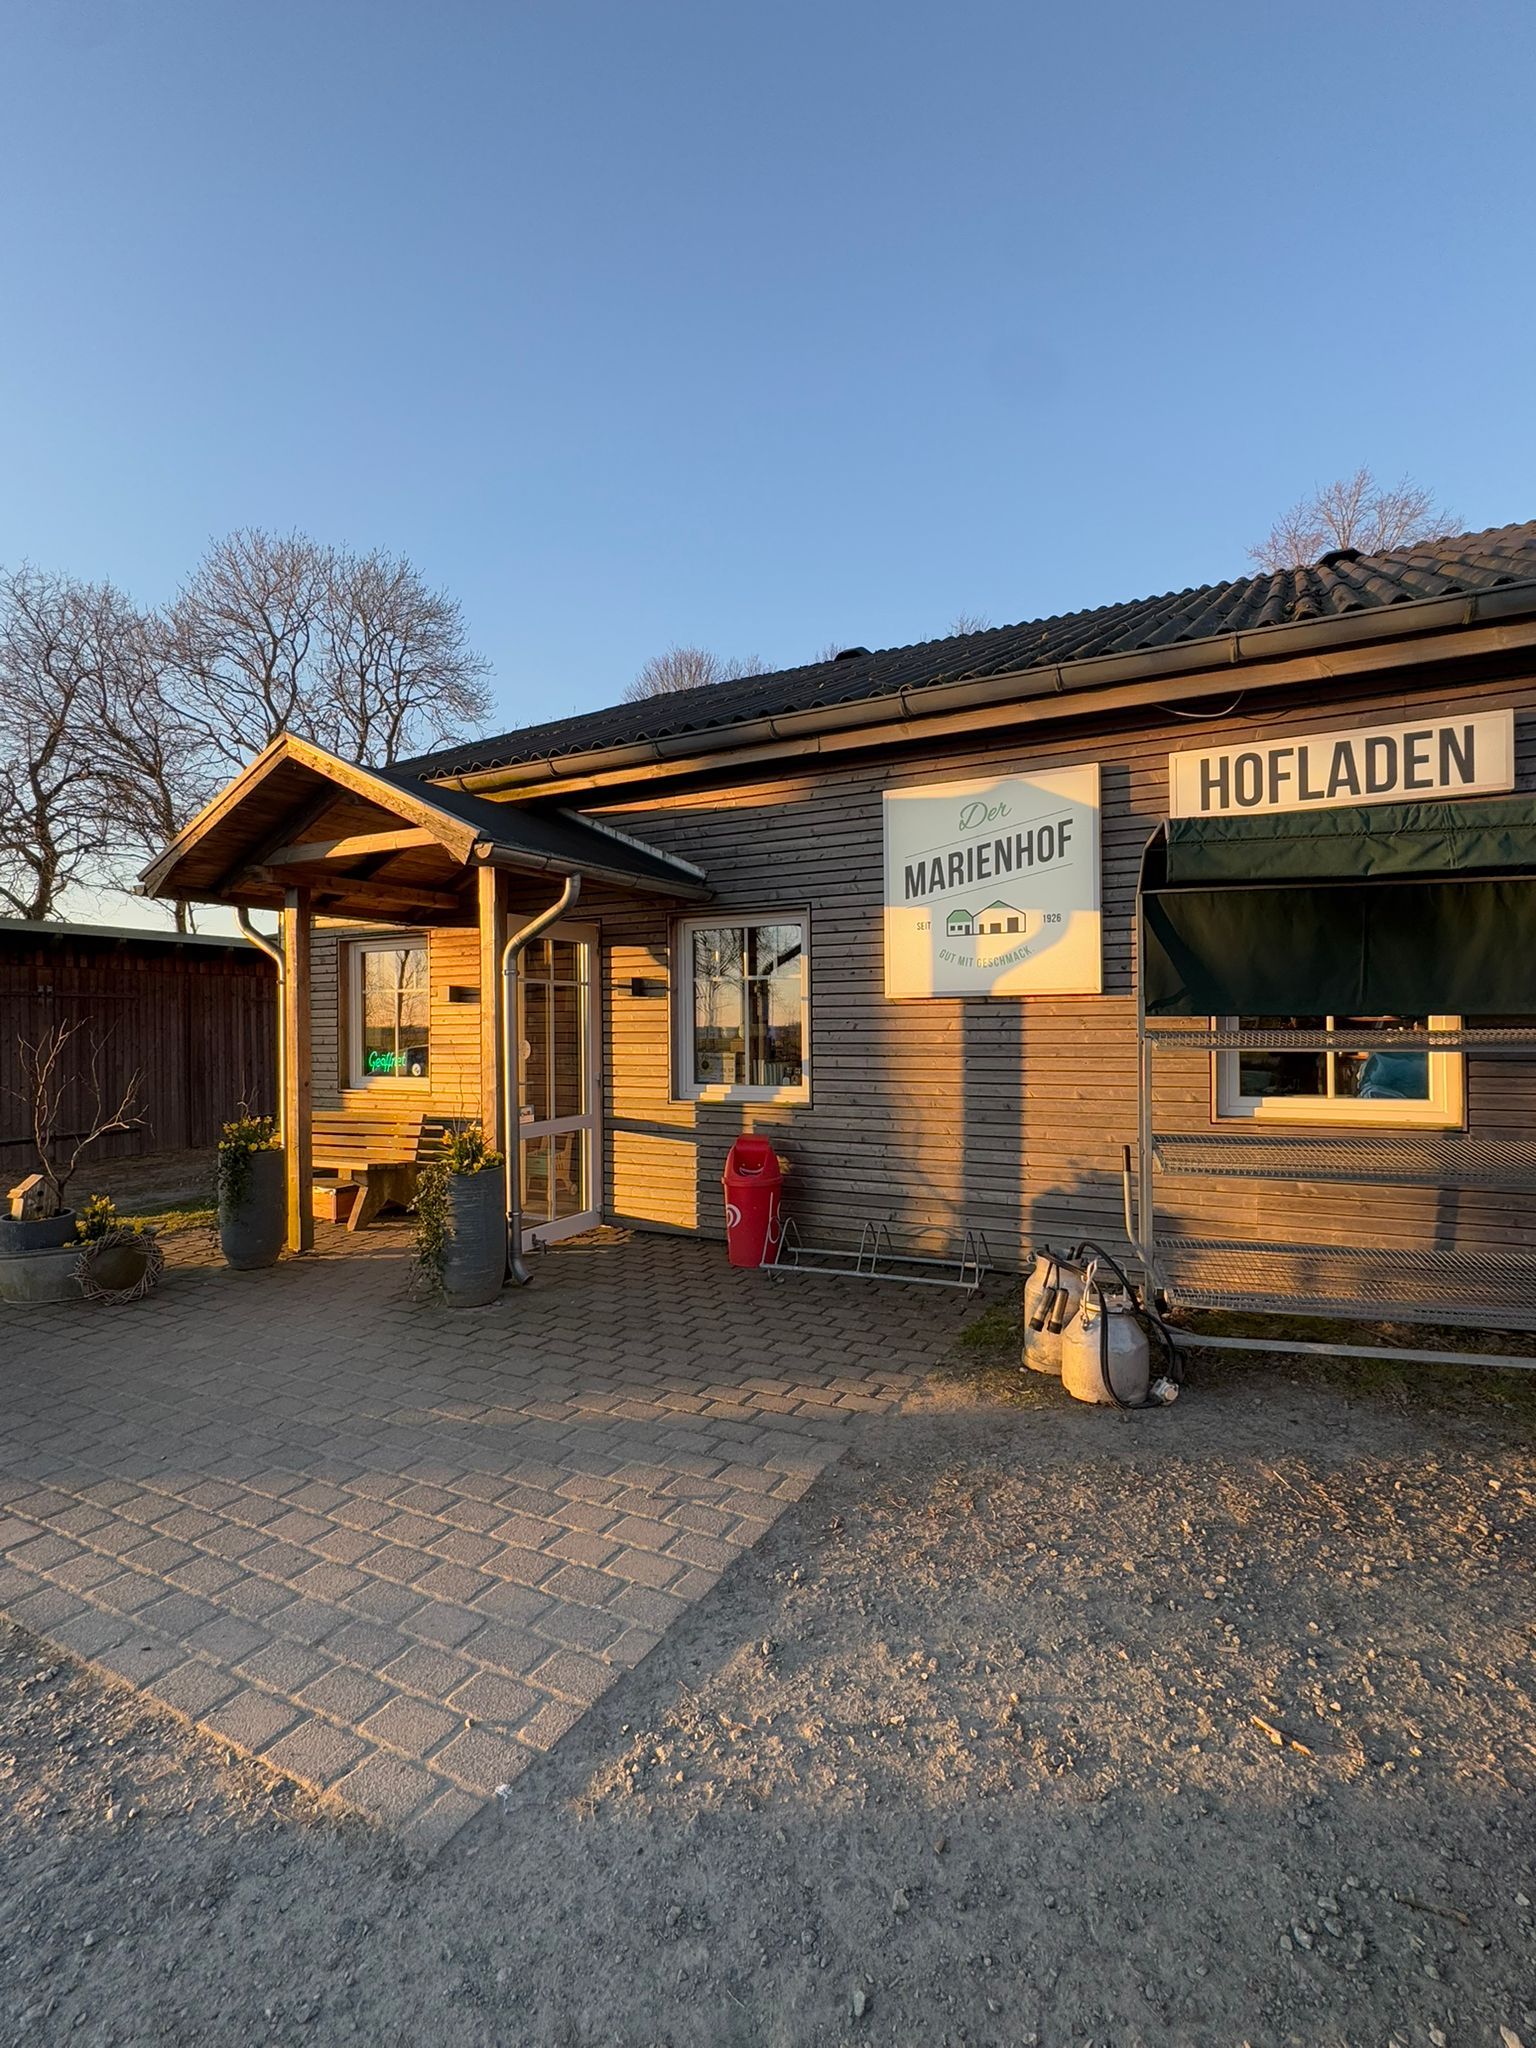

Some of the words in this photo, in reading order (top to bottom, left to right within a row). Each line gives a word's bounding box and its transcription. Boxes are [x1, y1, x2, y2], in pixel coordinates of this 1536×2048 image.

[1200, 724, 1475, 811] HOFLADEN
[958, 800, 1012, 831] Der
[904, 818, 1074, 900] MARIENHOF
[916, 921, 932, 931] SEIT
[1042, 913, 1062, 923] 1926
[938, 948, 956, 962] GUT
[957, 955, 974, 968] MIT
[976, 946, 1032, 969] GESCHMACK
